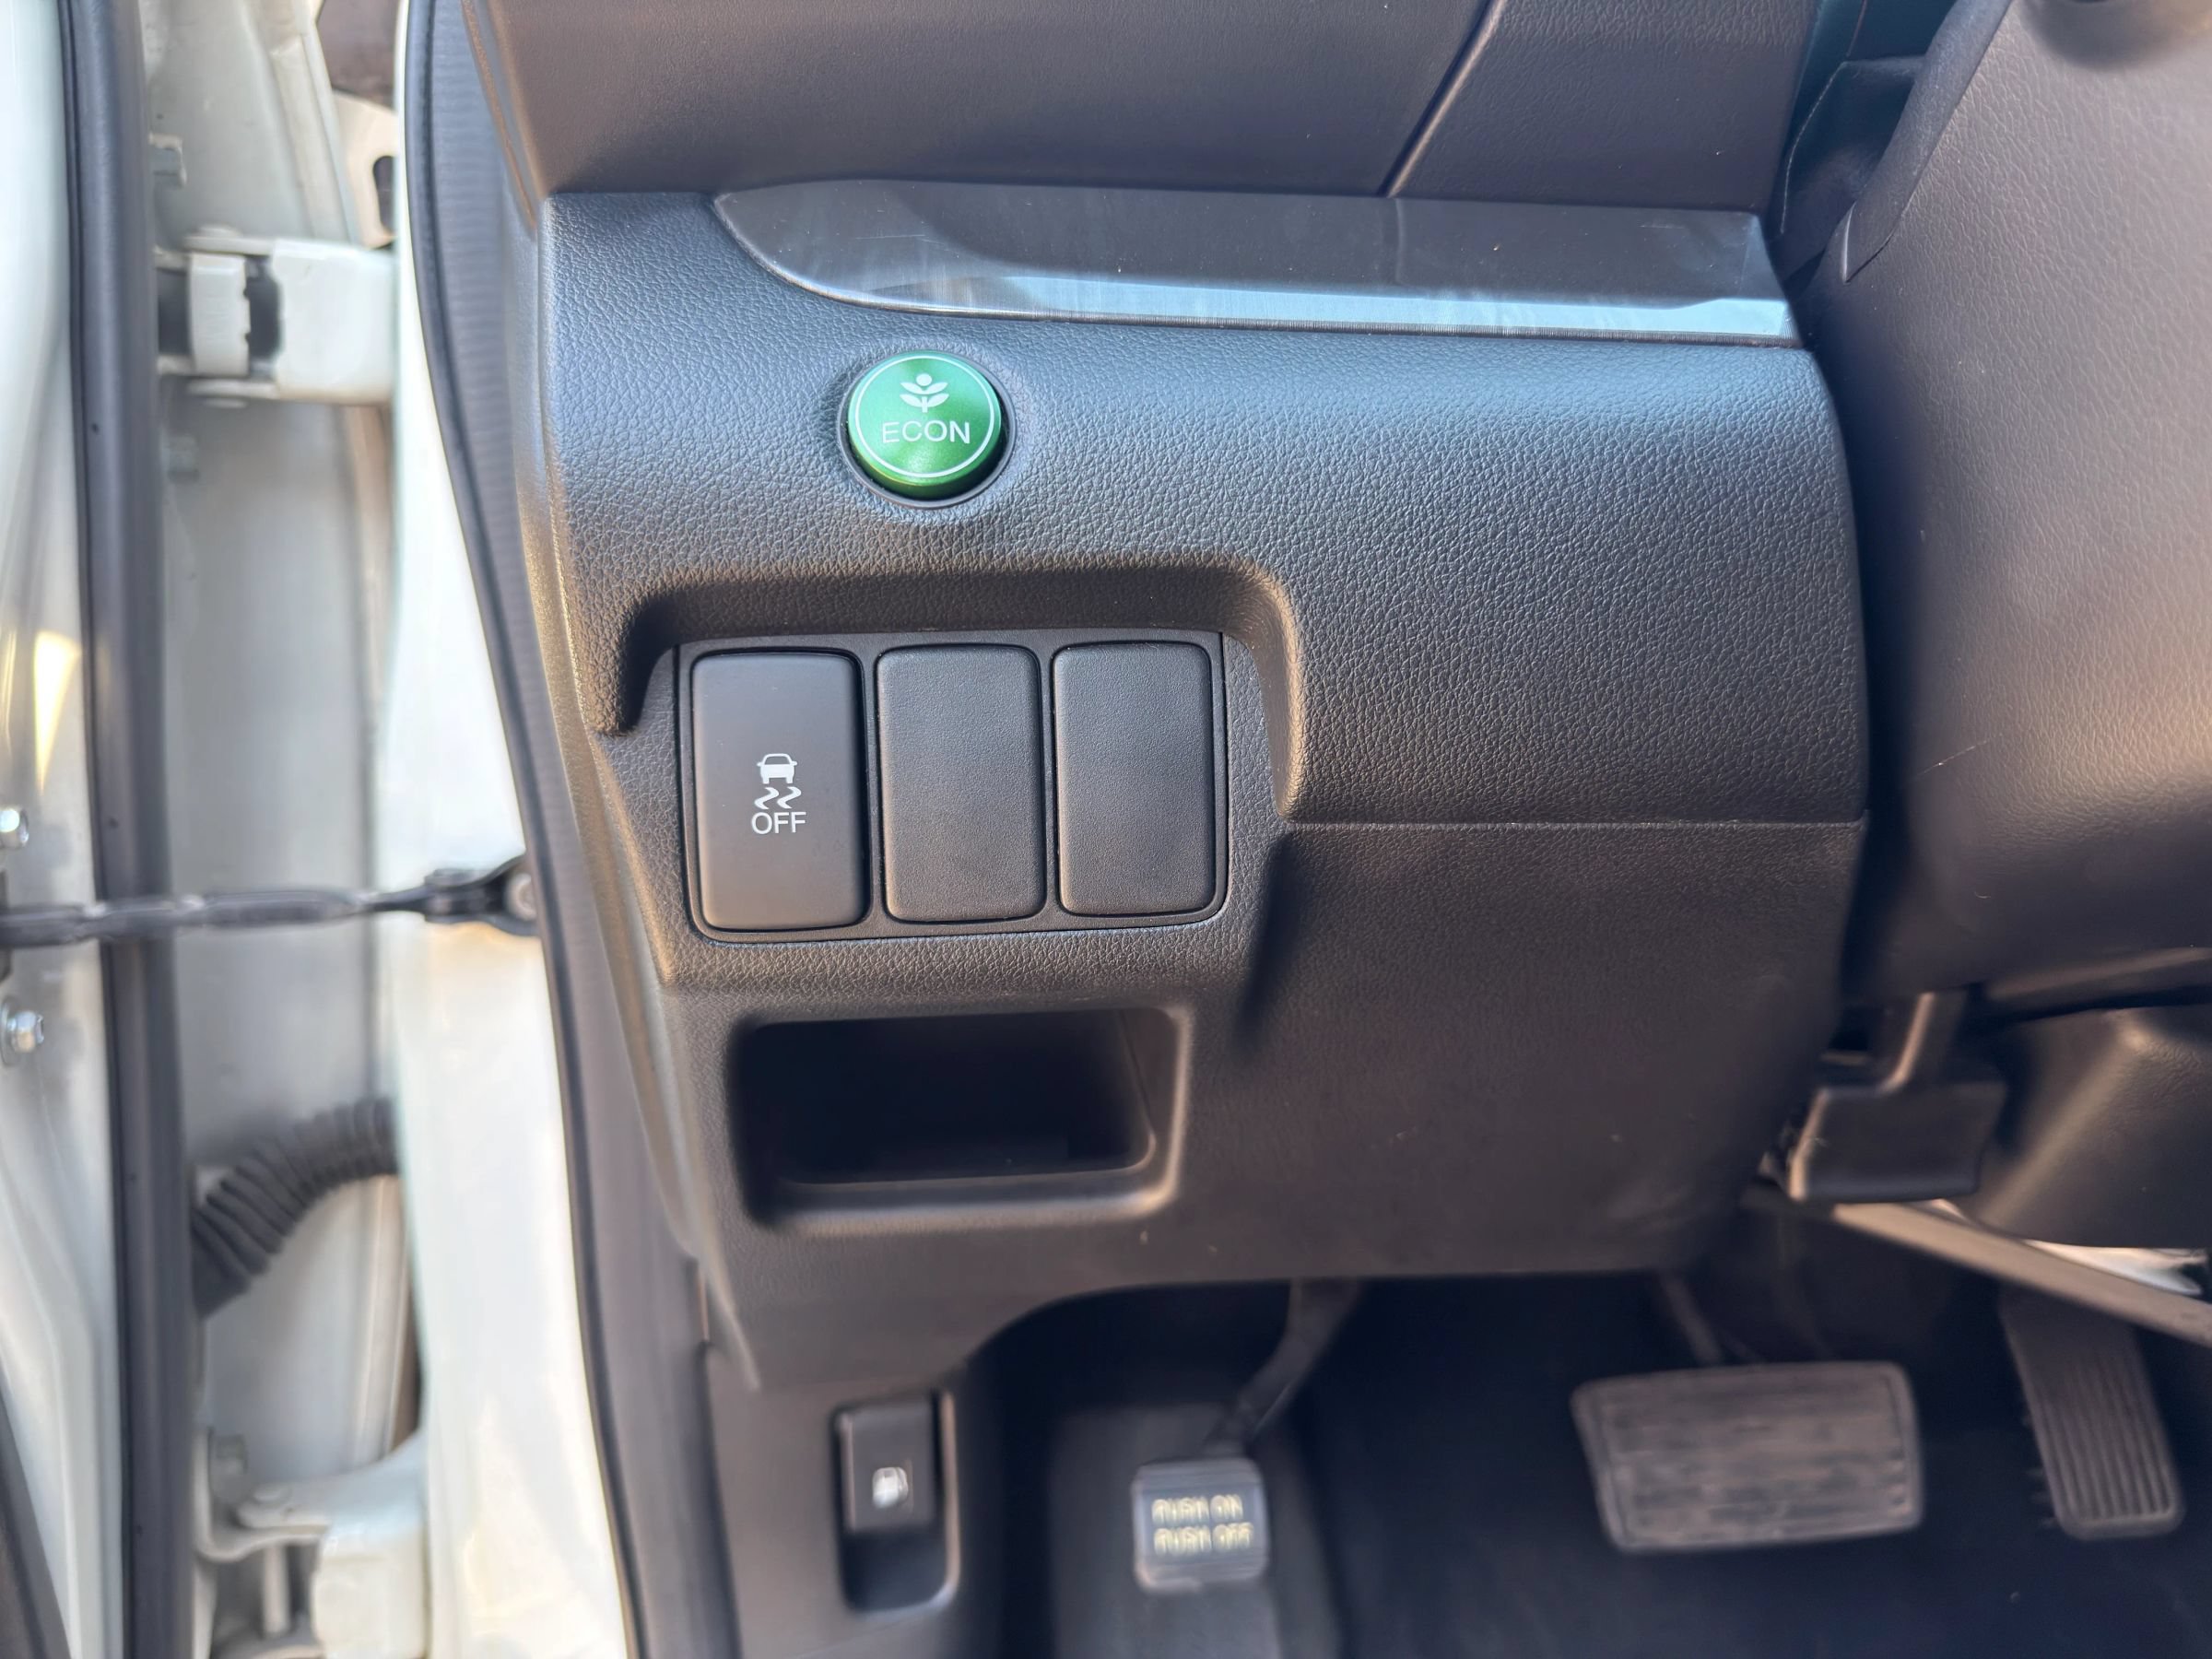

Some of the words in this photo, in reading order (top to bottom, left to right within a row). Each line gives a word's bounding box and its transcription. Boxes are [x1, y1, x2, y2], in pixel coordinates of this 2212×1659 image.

[881, 419, 971, 444] ECON
[751, 811, 806, 835] OFF
[1210, 1494, 1243, 1521] ON
[1213, 1523, 1253, 1552] OFF
